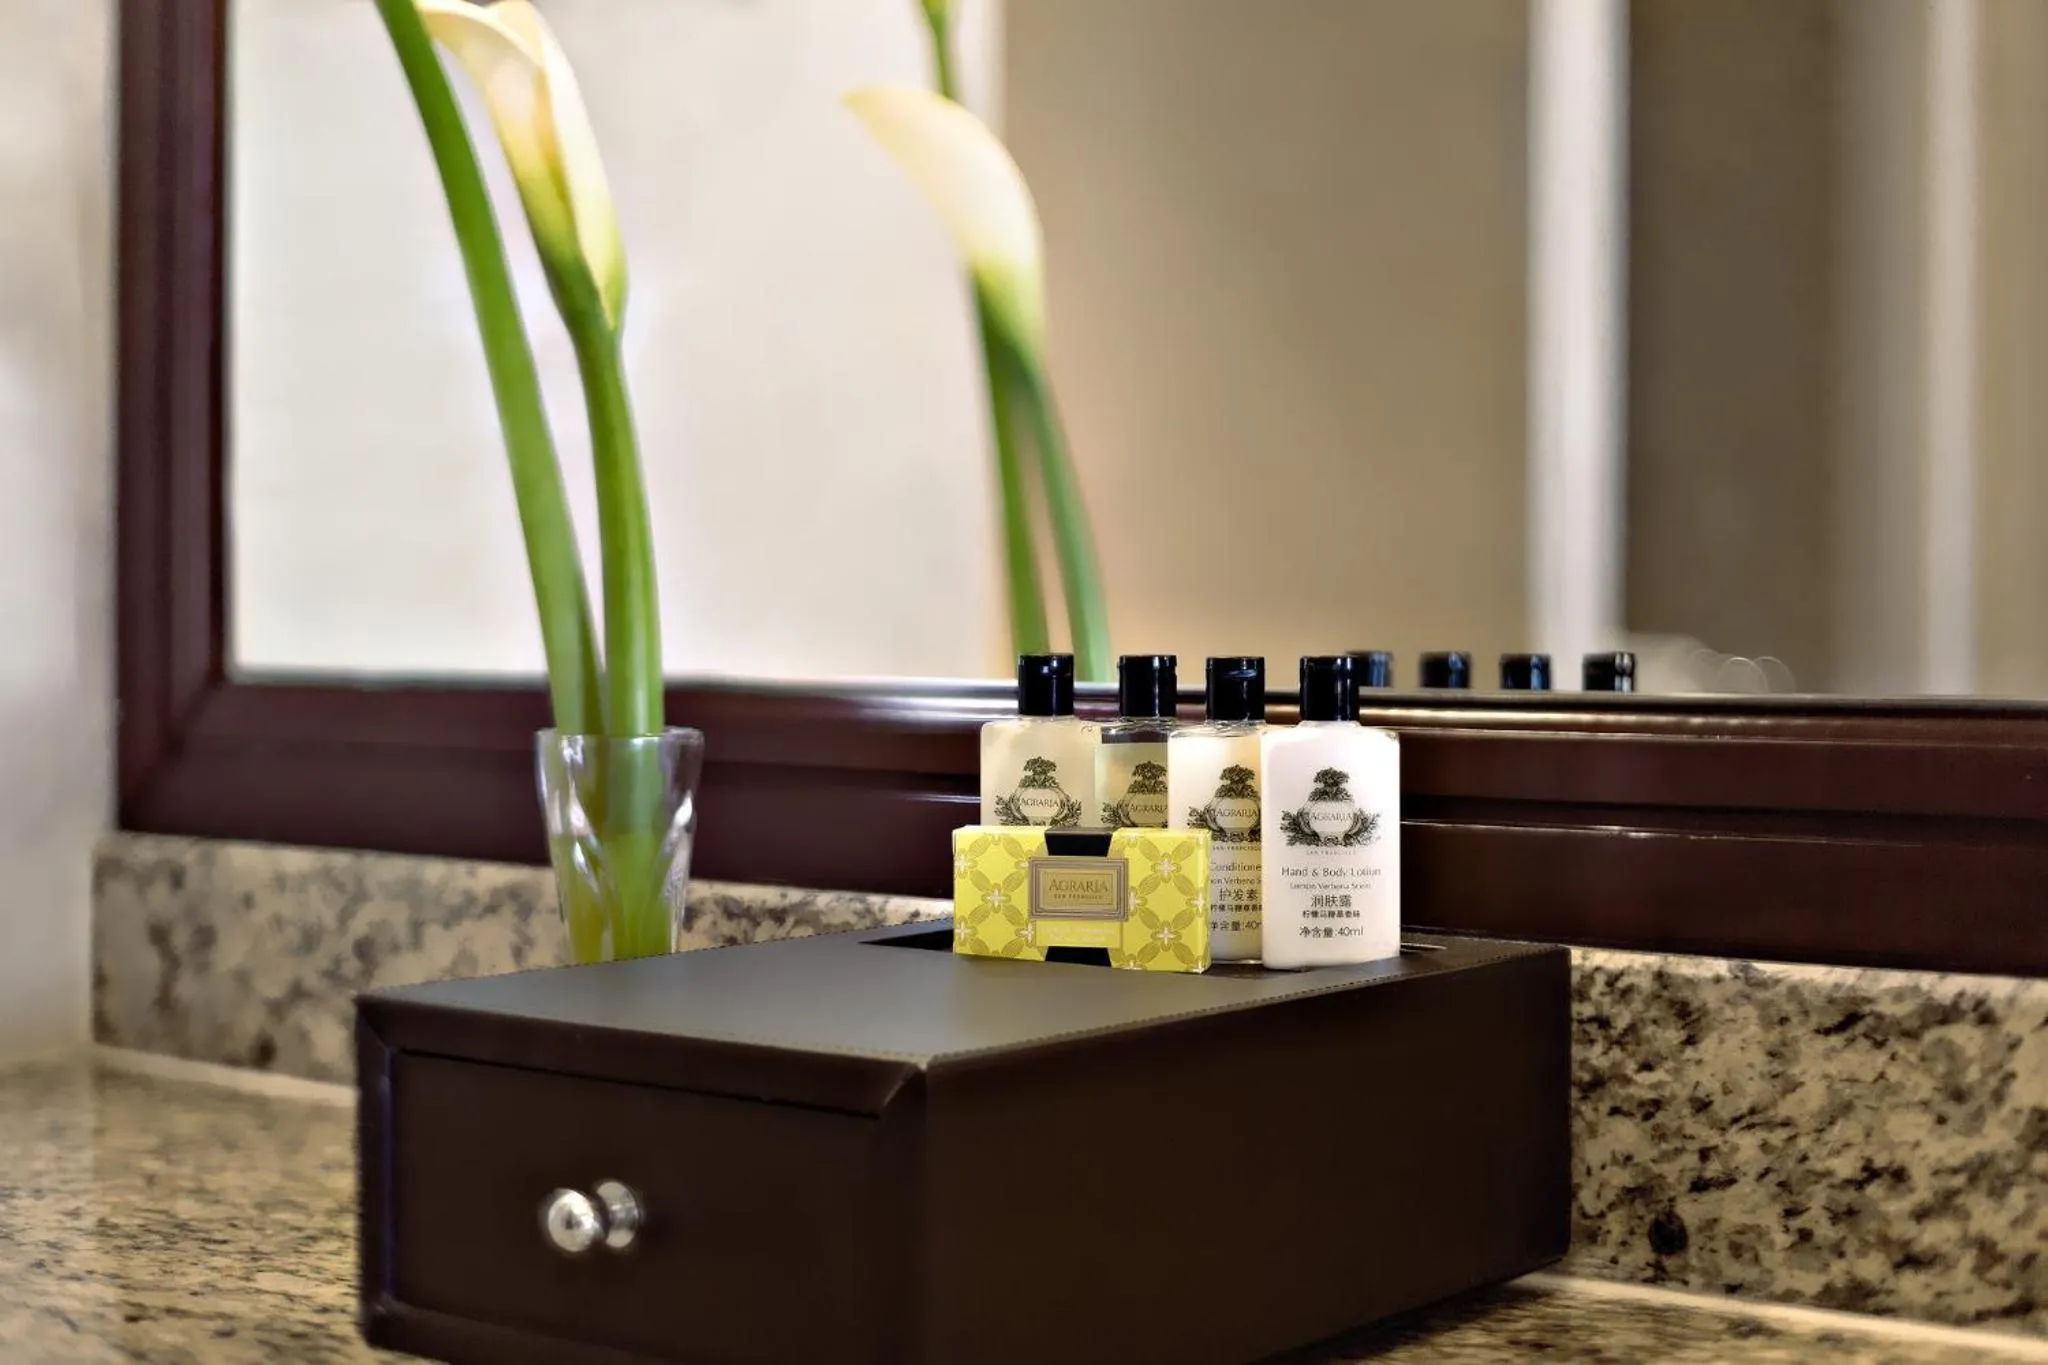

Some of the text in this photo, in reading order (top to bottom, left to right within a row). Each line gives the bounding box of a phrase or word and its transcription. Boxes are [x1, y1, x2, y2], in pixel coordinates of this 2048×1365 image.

[1020, 798, 1059, 807] AGRARIA
[1216, 808, 1257, 817] AGRARIA
[1210, 863, 1261, 872] Conditione
[1281, 867, 1382, 878] Hand & Body Lotion
[1049, 879, 1108, 893] AGRARIA
[1219, 888, 1259, 901] 护发素
[1311, 894, 1352, 908] 润肤露
